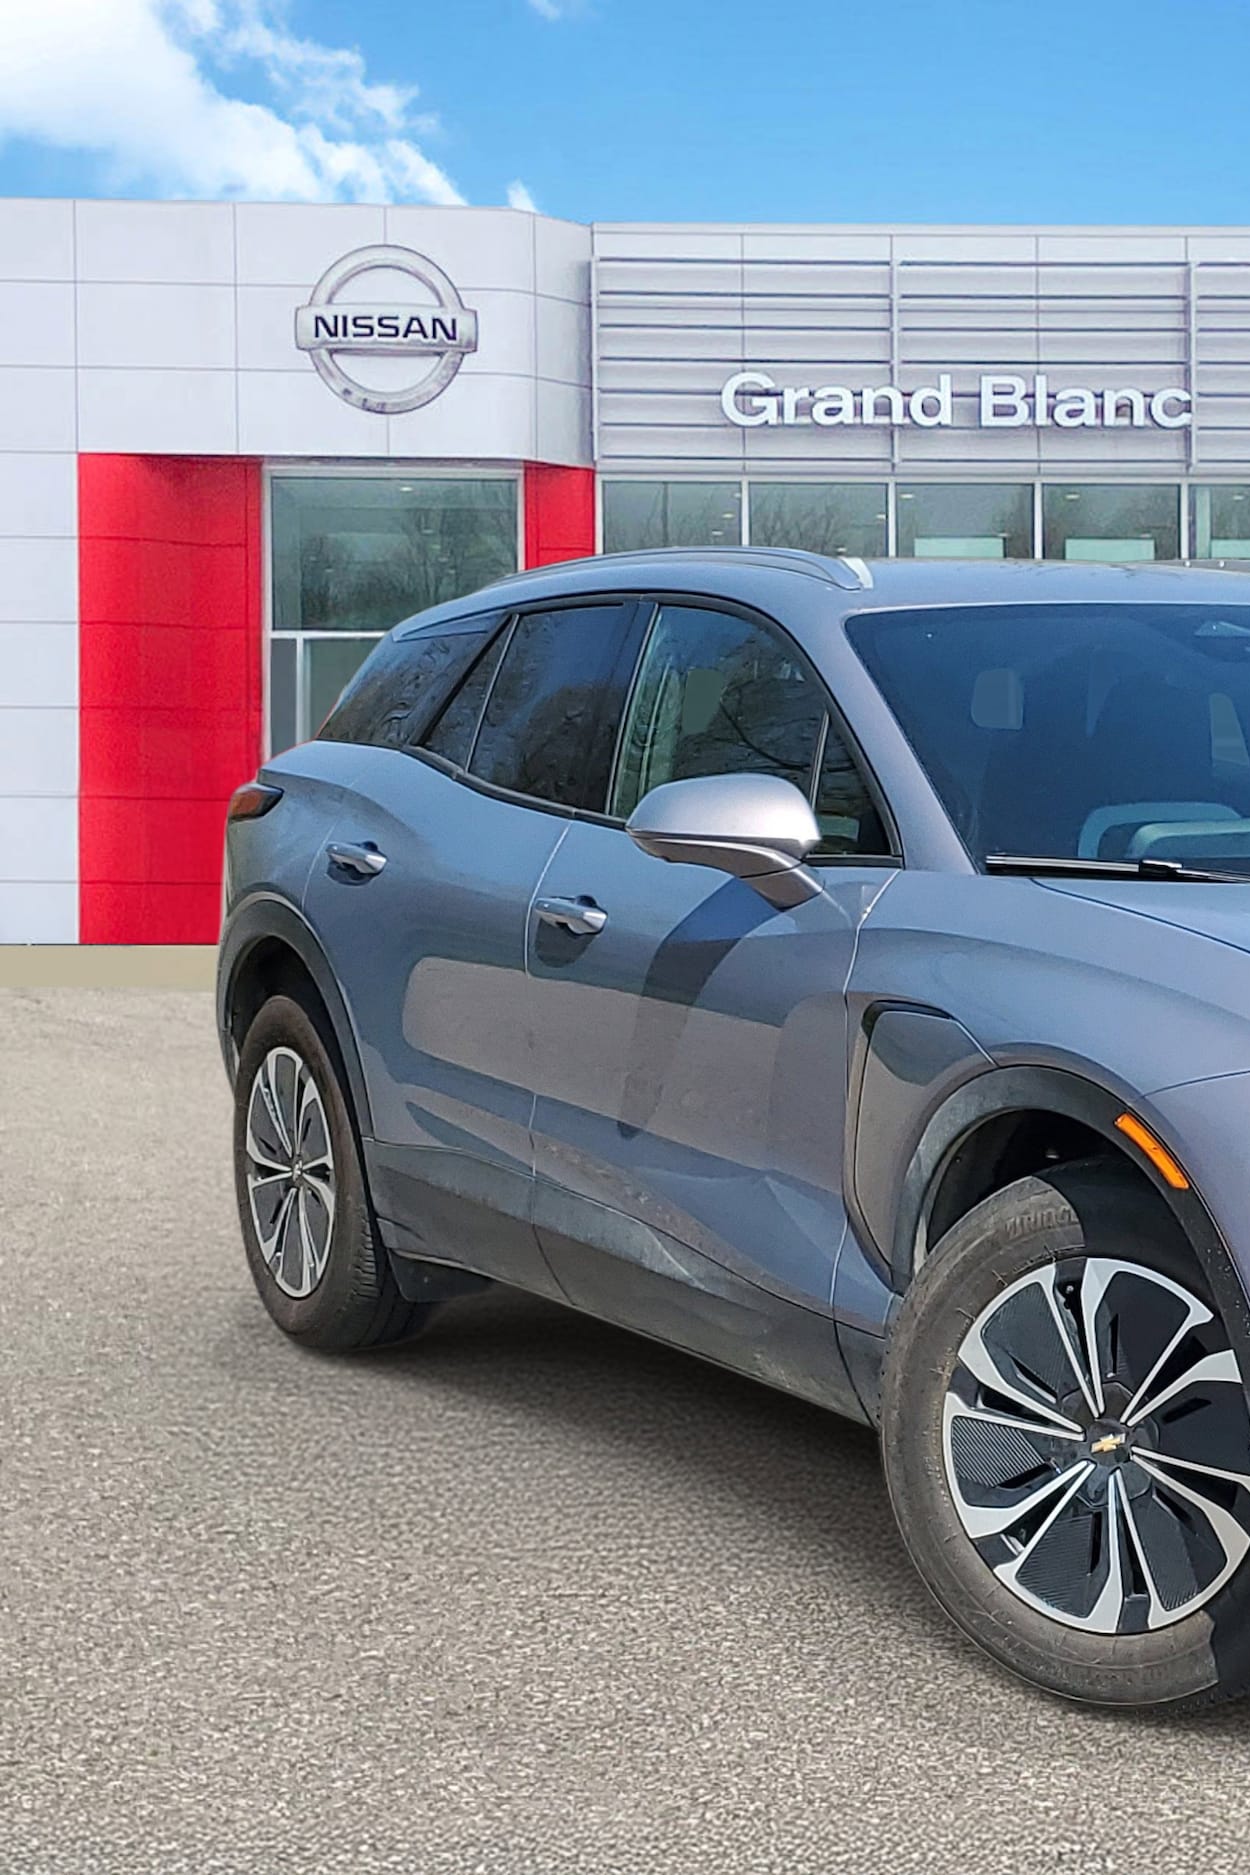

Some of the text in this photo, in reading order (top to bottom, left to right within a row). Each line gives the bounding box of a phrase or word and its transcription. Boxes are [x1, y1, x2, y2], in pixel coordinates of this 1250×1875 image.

[313, 315, 457, 341] NISSAN
[720, 371, 1193, 428] Grand Blanc
